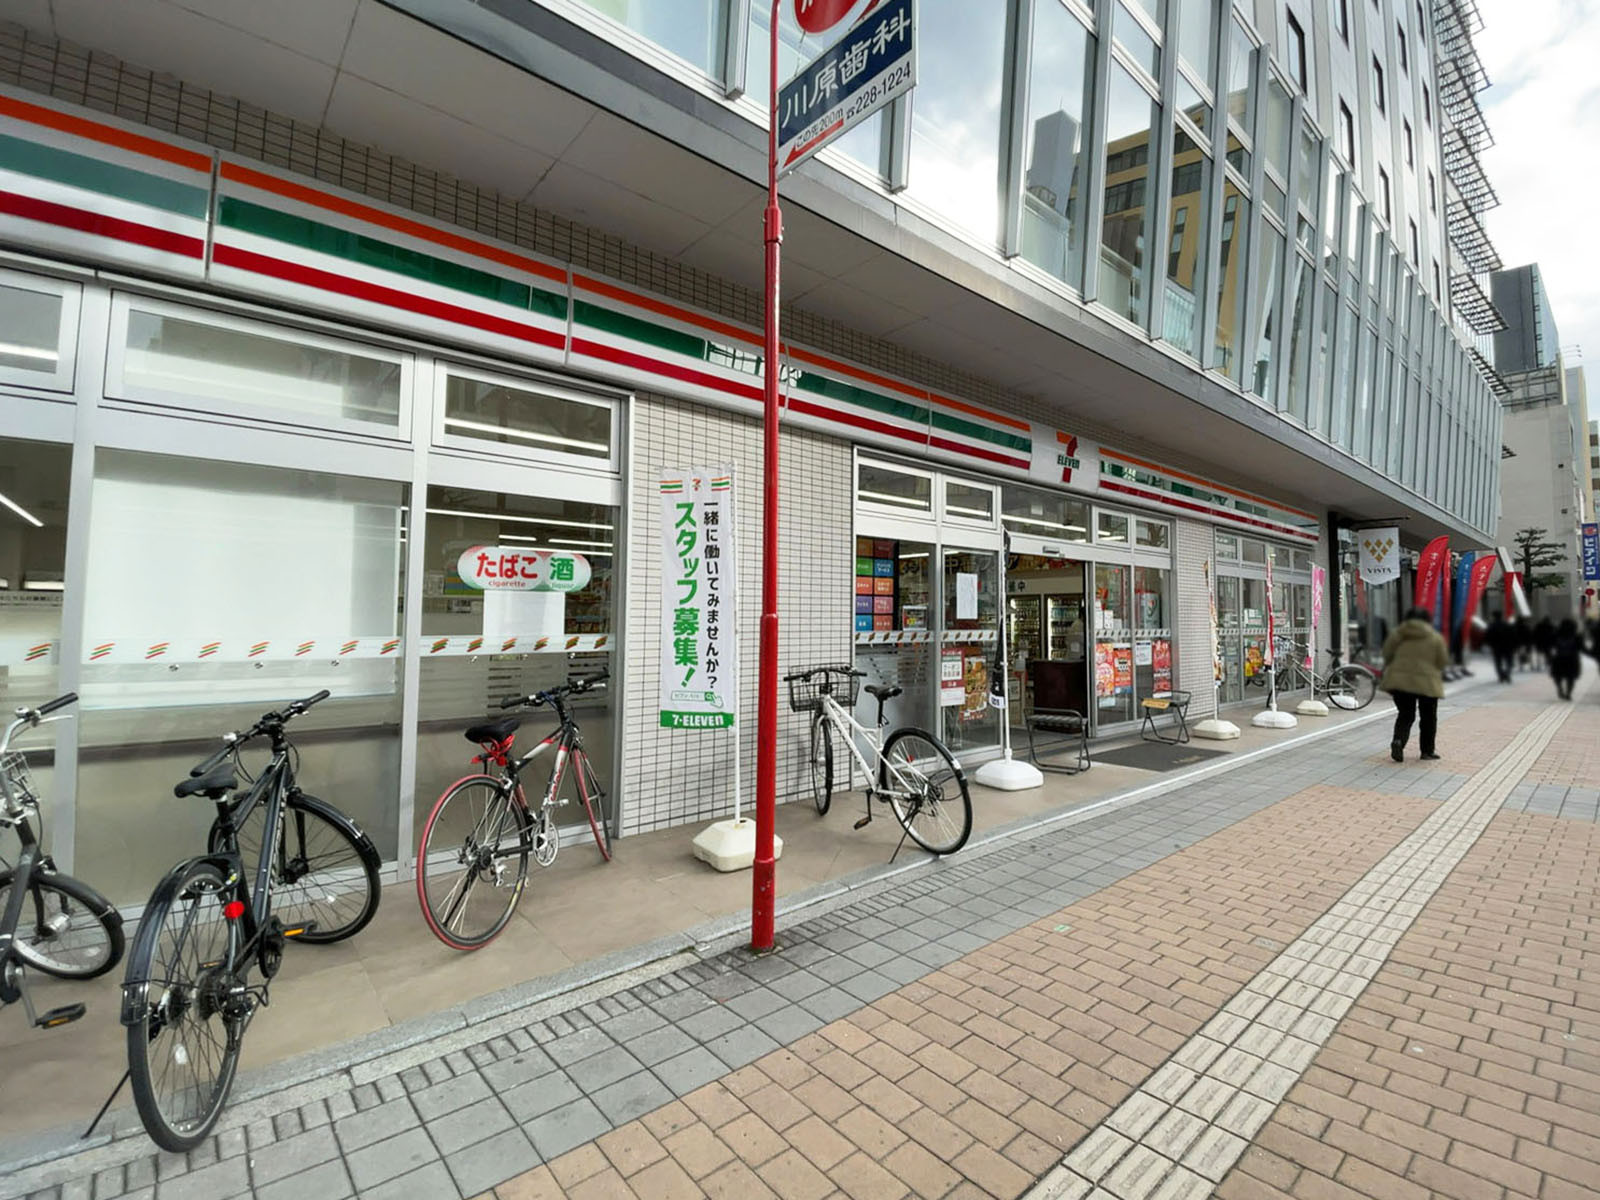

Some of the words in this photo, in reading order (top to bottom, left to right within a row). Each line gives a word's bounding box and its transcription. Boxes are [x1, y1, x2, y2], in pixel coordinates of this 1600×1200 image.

[781, 8, 911, 128] 川原歯科
[855, 62, 911, 115] 228-1224
[476, 552, 538, 579] たばこ
[550, 557, 575, 581] 酒
[673, 502, 700, 688] スタッフ募集！
[704, 501, 720, 689] 一緒に働いてみませんか？
